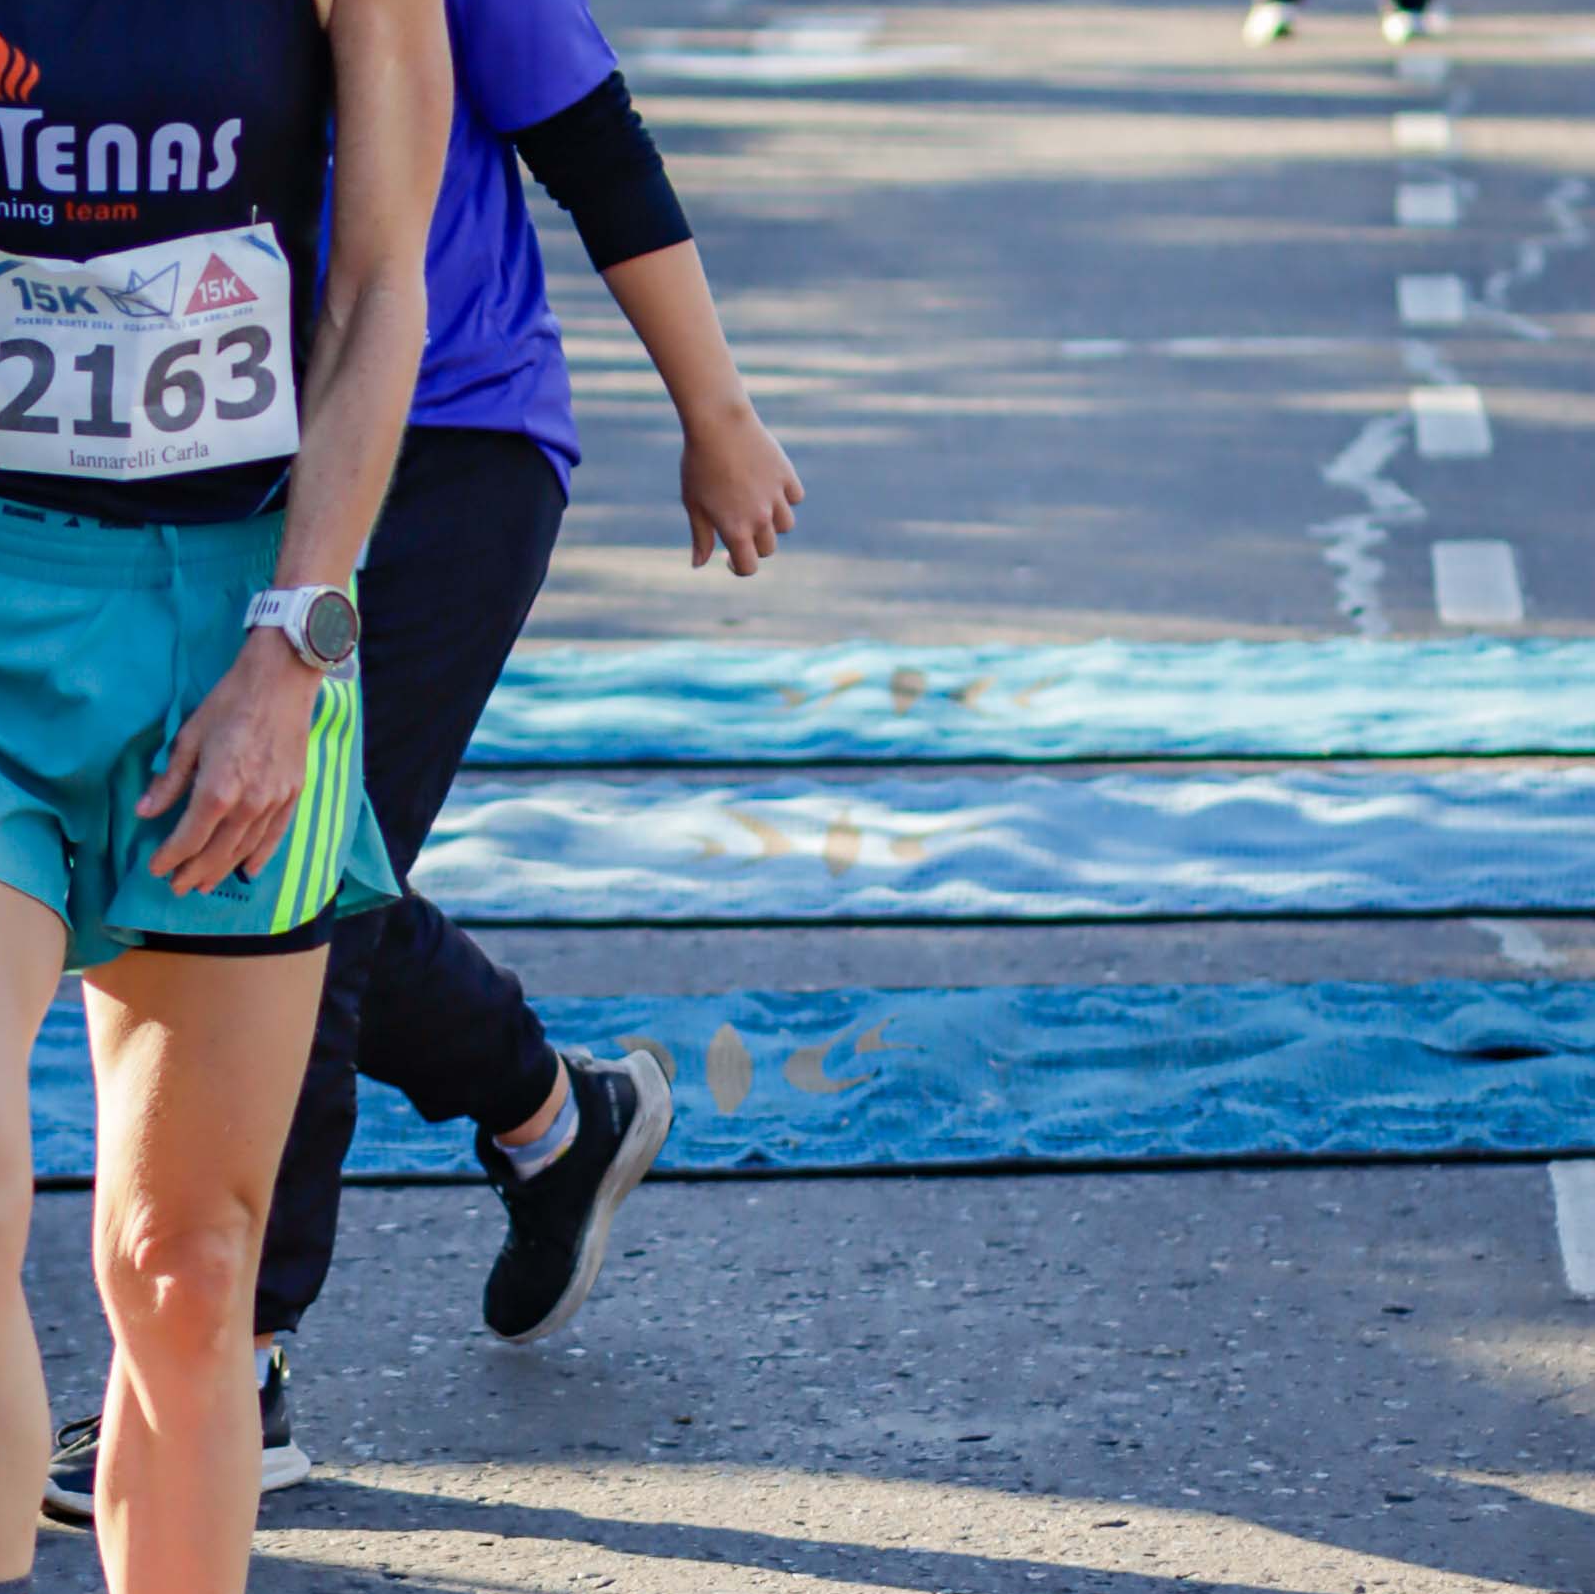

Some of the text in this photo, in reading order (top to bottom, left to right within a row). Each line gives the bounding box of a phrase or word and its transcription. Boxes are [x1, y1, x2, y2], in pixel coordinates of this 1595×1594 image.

[65, 201, 138, 221] team
[11, 277, 99, 314] 15K
[198, 275, 241, 304] 15K
[69, 441, 209, 471] Iannarelli Carla
